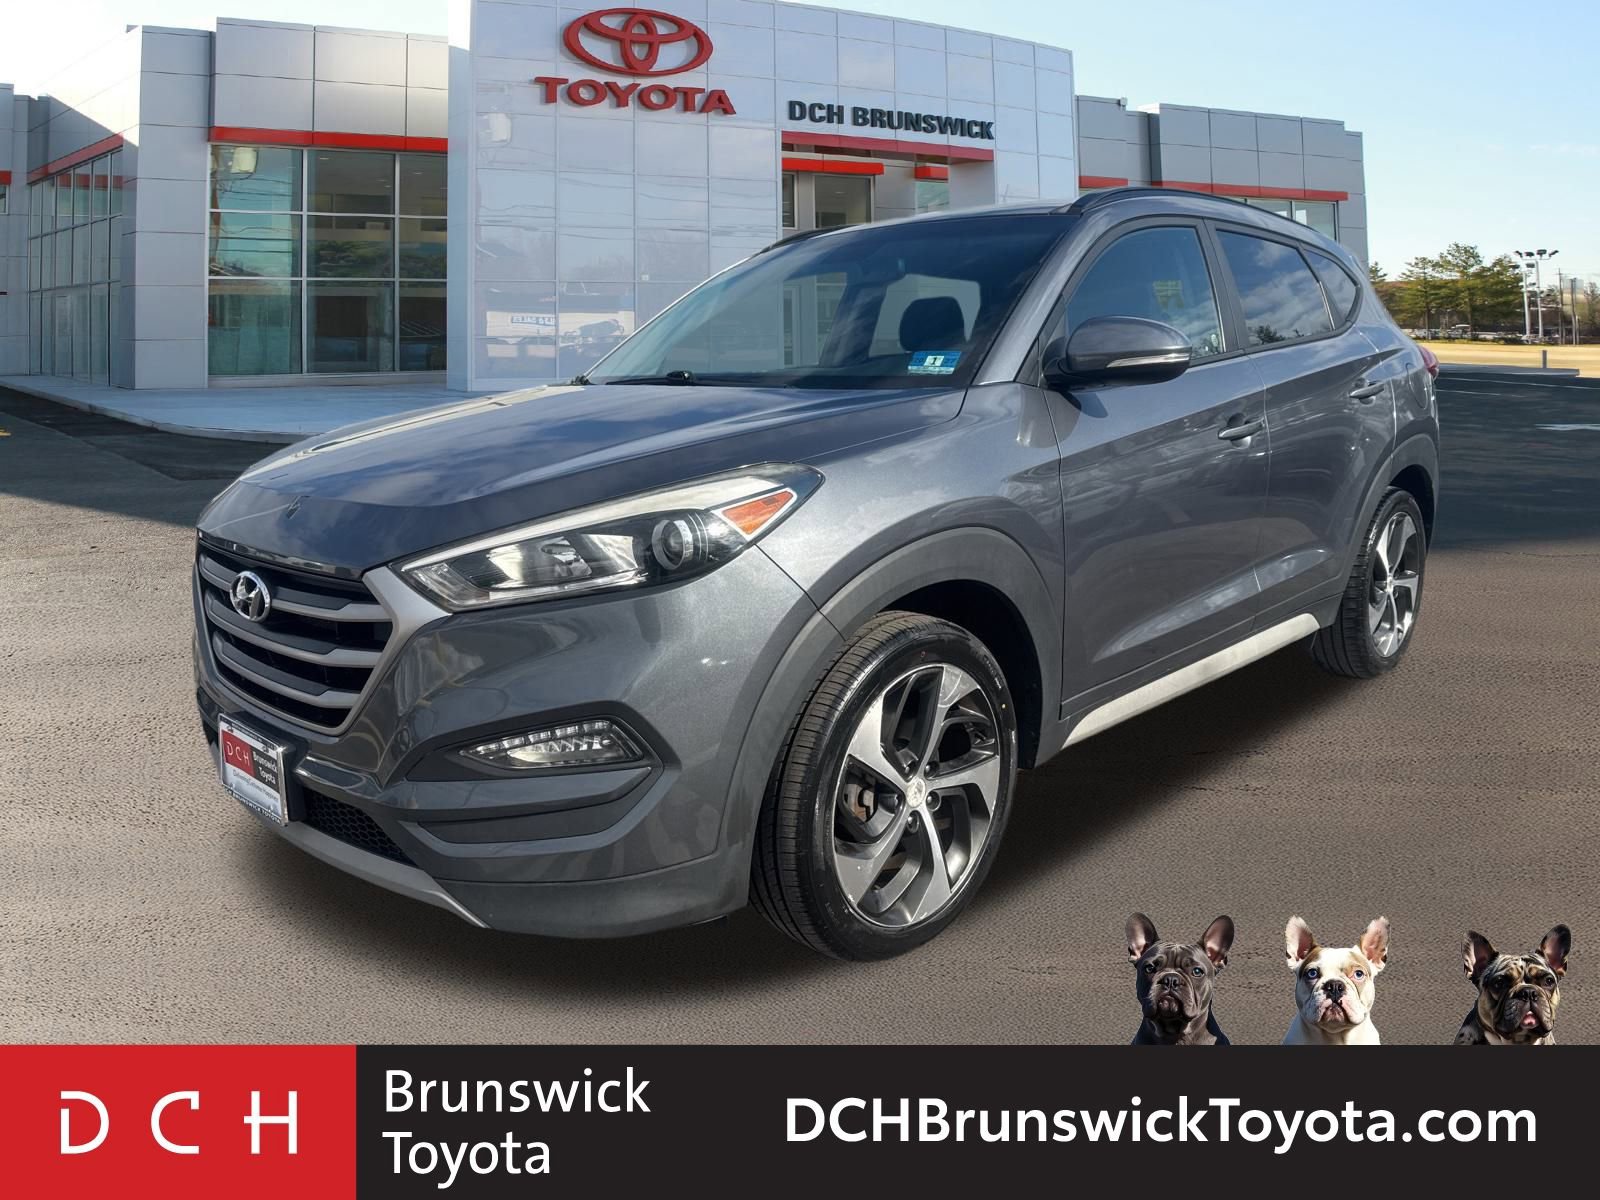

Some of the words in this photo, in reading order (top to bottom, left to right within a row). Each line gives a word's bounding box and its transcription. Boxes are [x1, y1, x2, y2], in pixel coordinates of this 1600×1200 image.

[534, 77, 736, 115] TOYOTA
[788, 100, 844, 124] DCH
[851, 106, 995, 140] BRUNSWICK
[226, 741, 250, 766] DCH
[259, 767, 277, 785] Toyota
